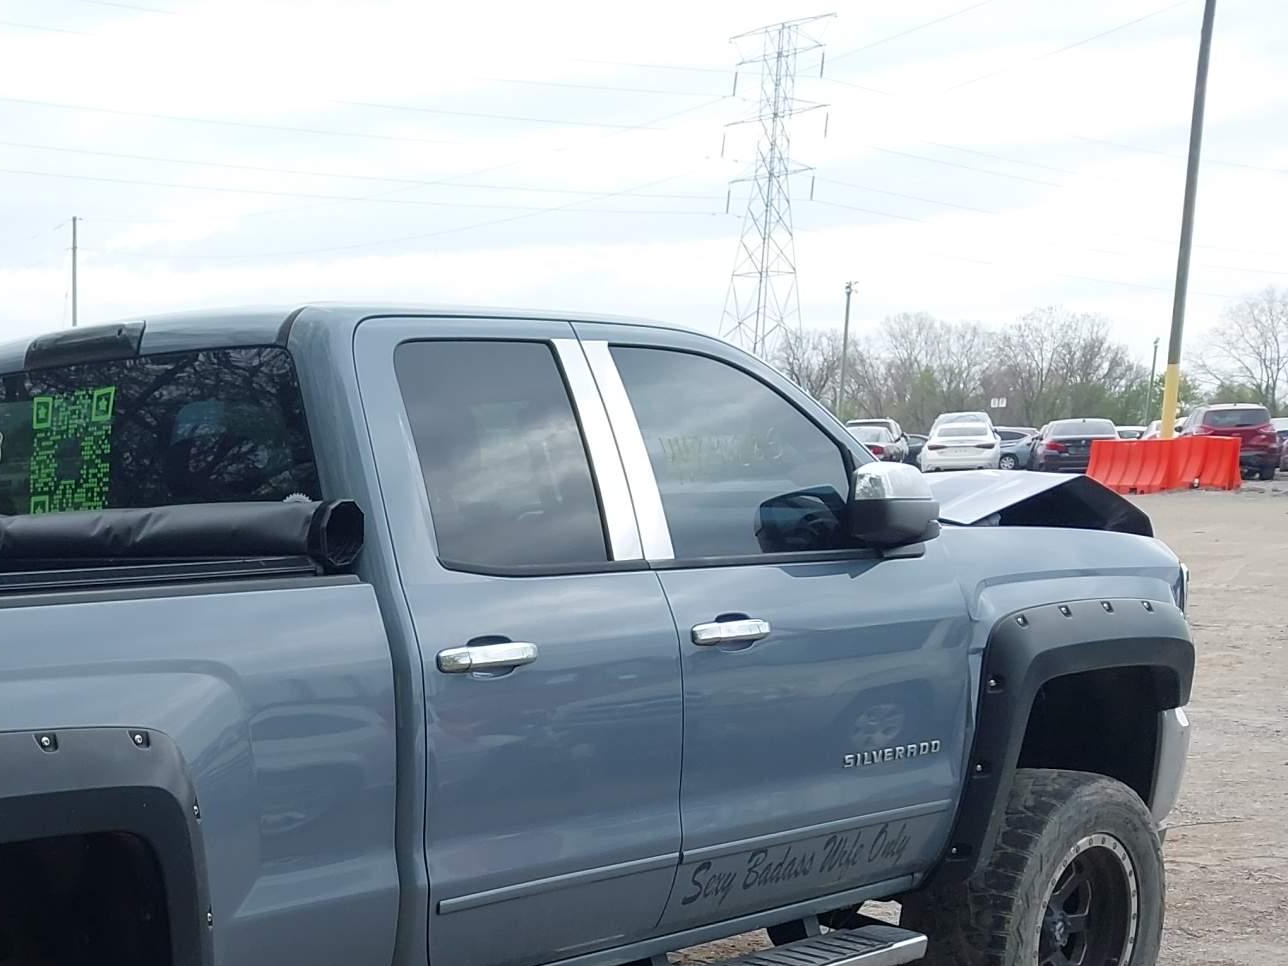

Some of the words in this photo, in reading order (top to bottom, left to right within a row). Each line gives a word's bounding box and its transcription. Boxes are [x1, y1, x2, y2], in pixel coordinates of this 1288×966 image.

[842, 740, 941, 769] SILVERADO
[681, 861, 738, 906] Sexy
[743, 846, 815, 890] Badass
[868, 822, 911, 864] Only
